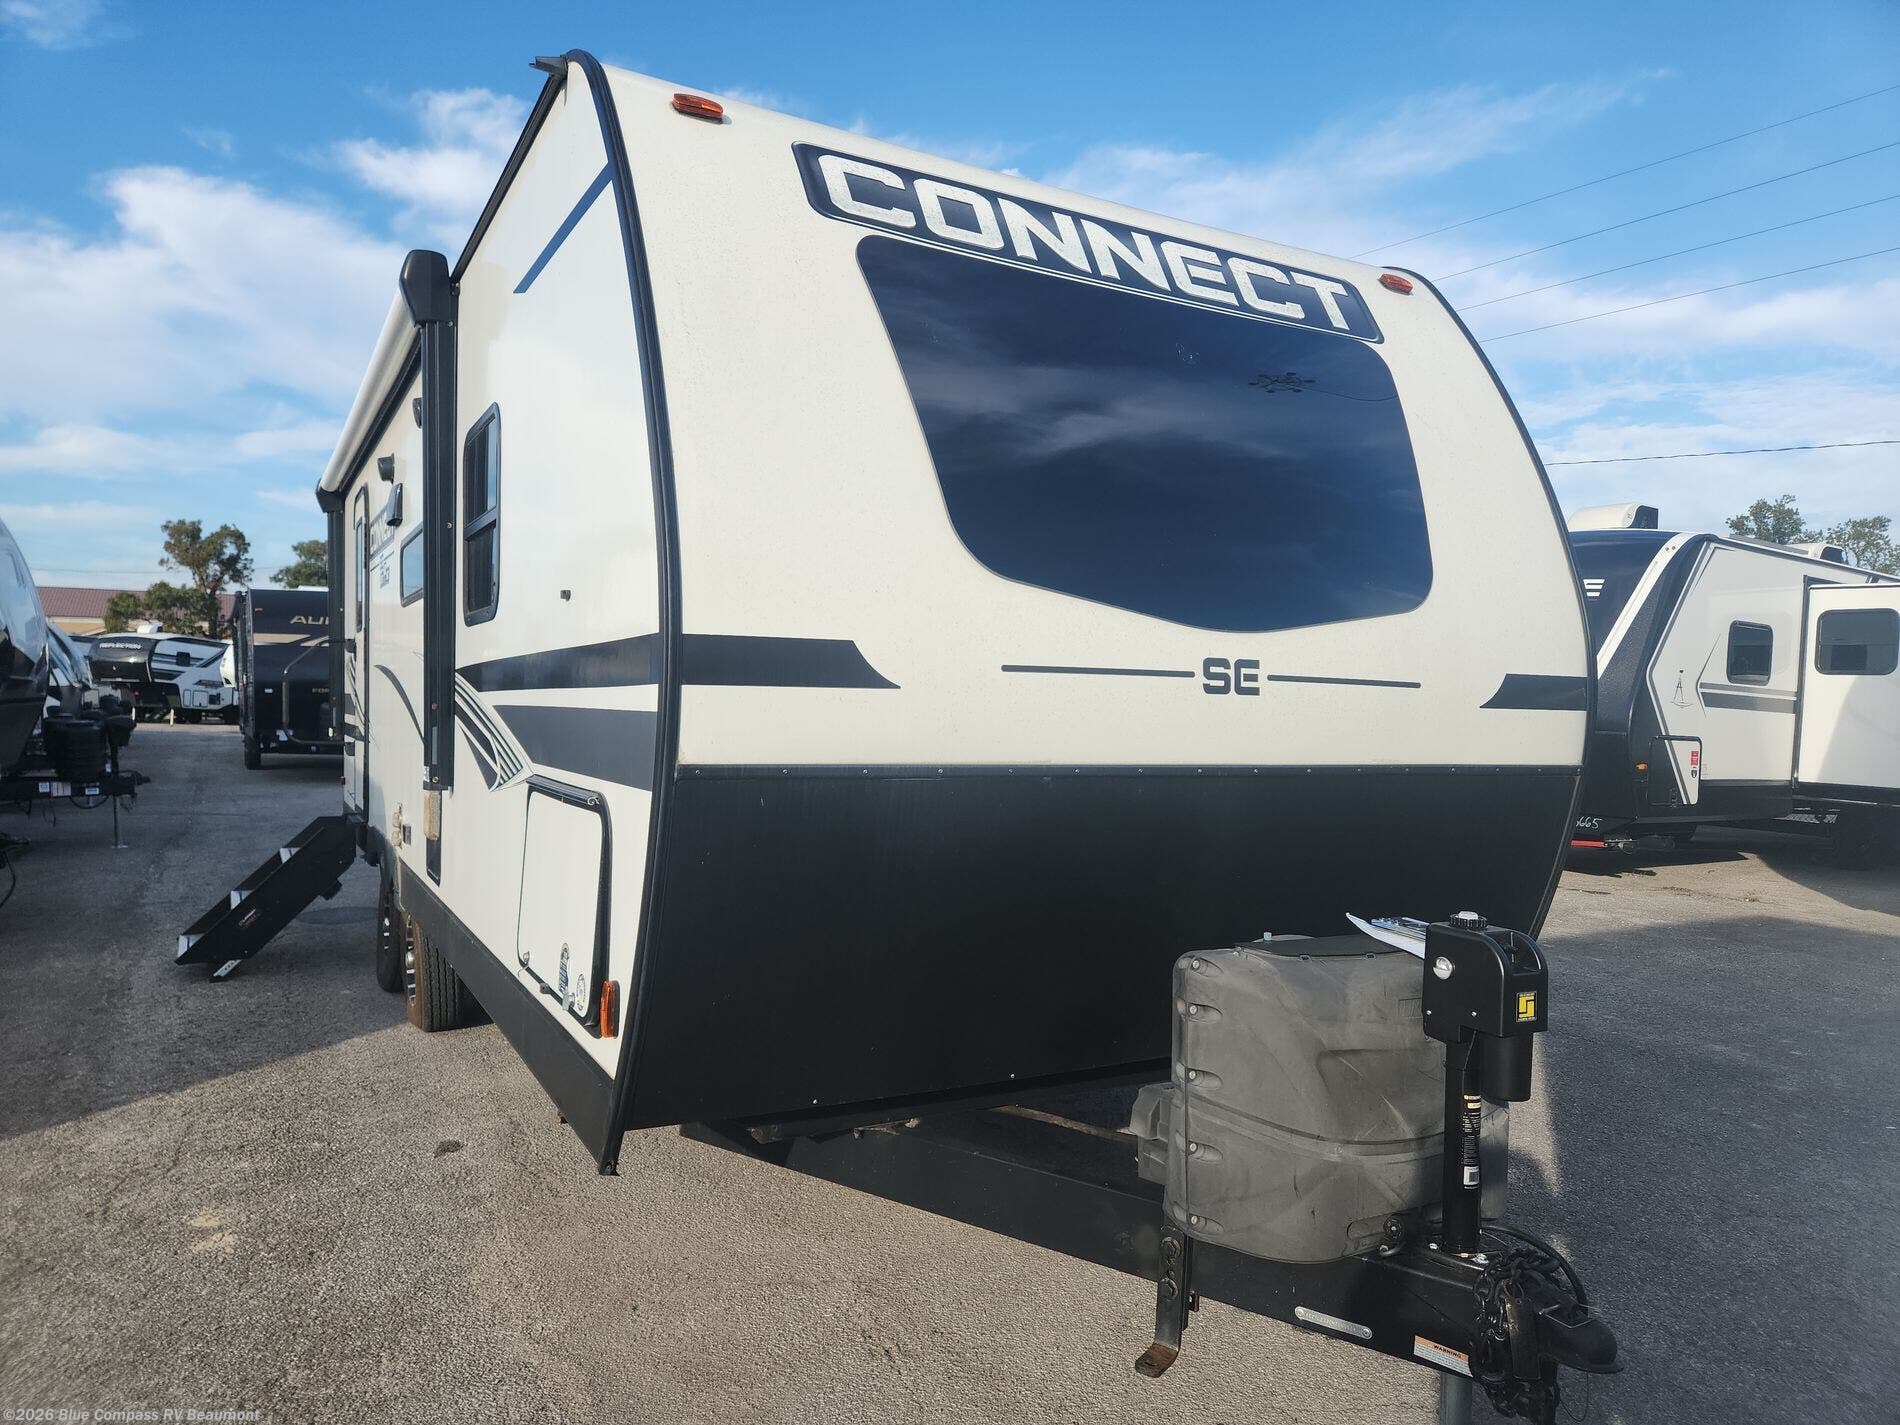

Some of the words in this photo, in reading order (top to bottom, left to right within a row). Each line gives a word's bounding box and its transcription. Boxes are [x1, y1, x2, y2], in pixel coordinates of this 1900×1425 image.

[818, 153, 1350, 330] CONNECT
[1203, 657, 1260, 696] SE
[1434, 1345, 1462, 1359] WARNING
